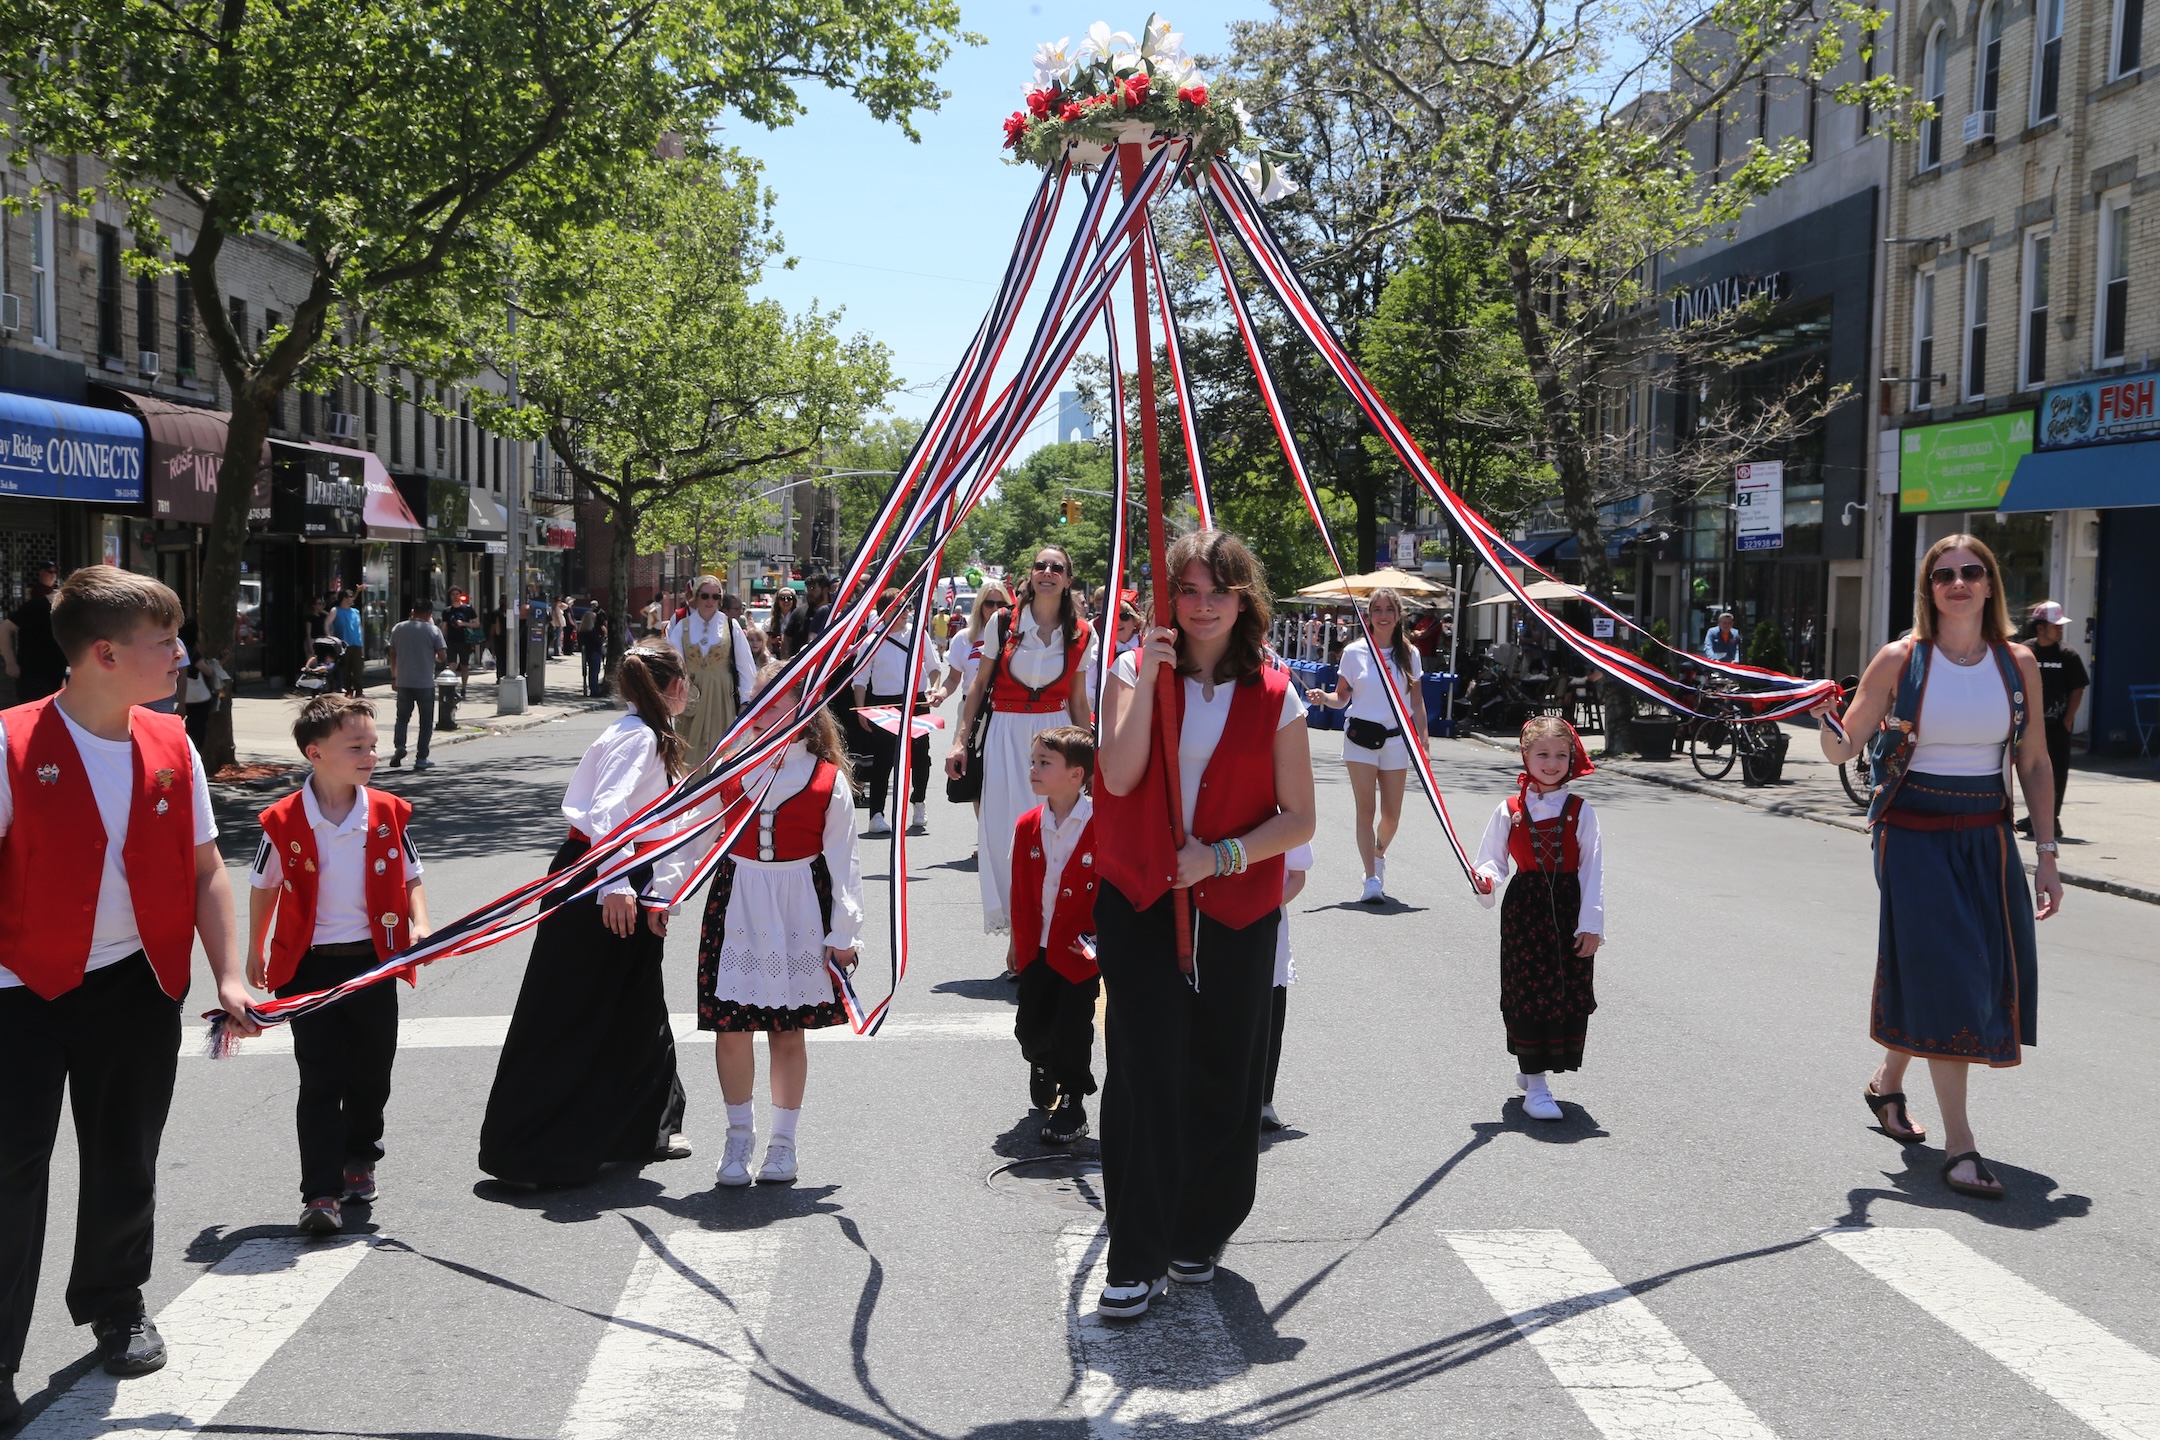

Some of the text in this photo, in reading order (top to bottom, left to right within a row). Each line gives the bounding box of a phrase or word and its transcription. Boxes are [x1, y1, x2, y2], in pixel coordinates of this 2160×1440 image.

[1672, 271, 1780, 332] OMONIA CAFE
[2051, 394, 2074, 418] Bay
[2098, 379, 2155, 423] FISH
[2048, 416, 2076, 440] Ridge
[0, 434, 140, 480] ay Ridge CONNECTS
[1936, 441, 1994, 460] SOUTH BROOKLYN
[195, 455, 223, 493] NA
[1740, 494, 1748, 506] 2
[1744, 540, 1771, 549] 323938
[535, 608, 543, 619] P
